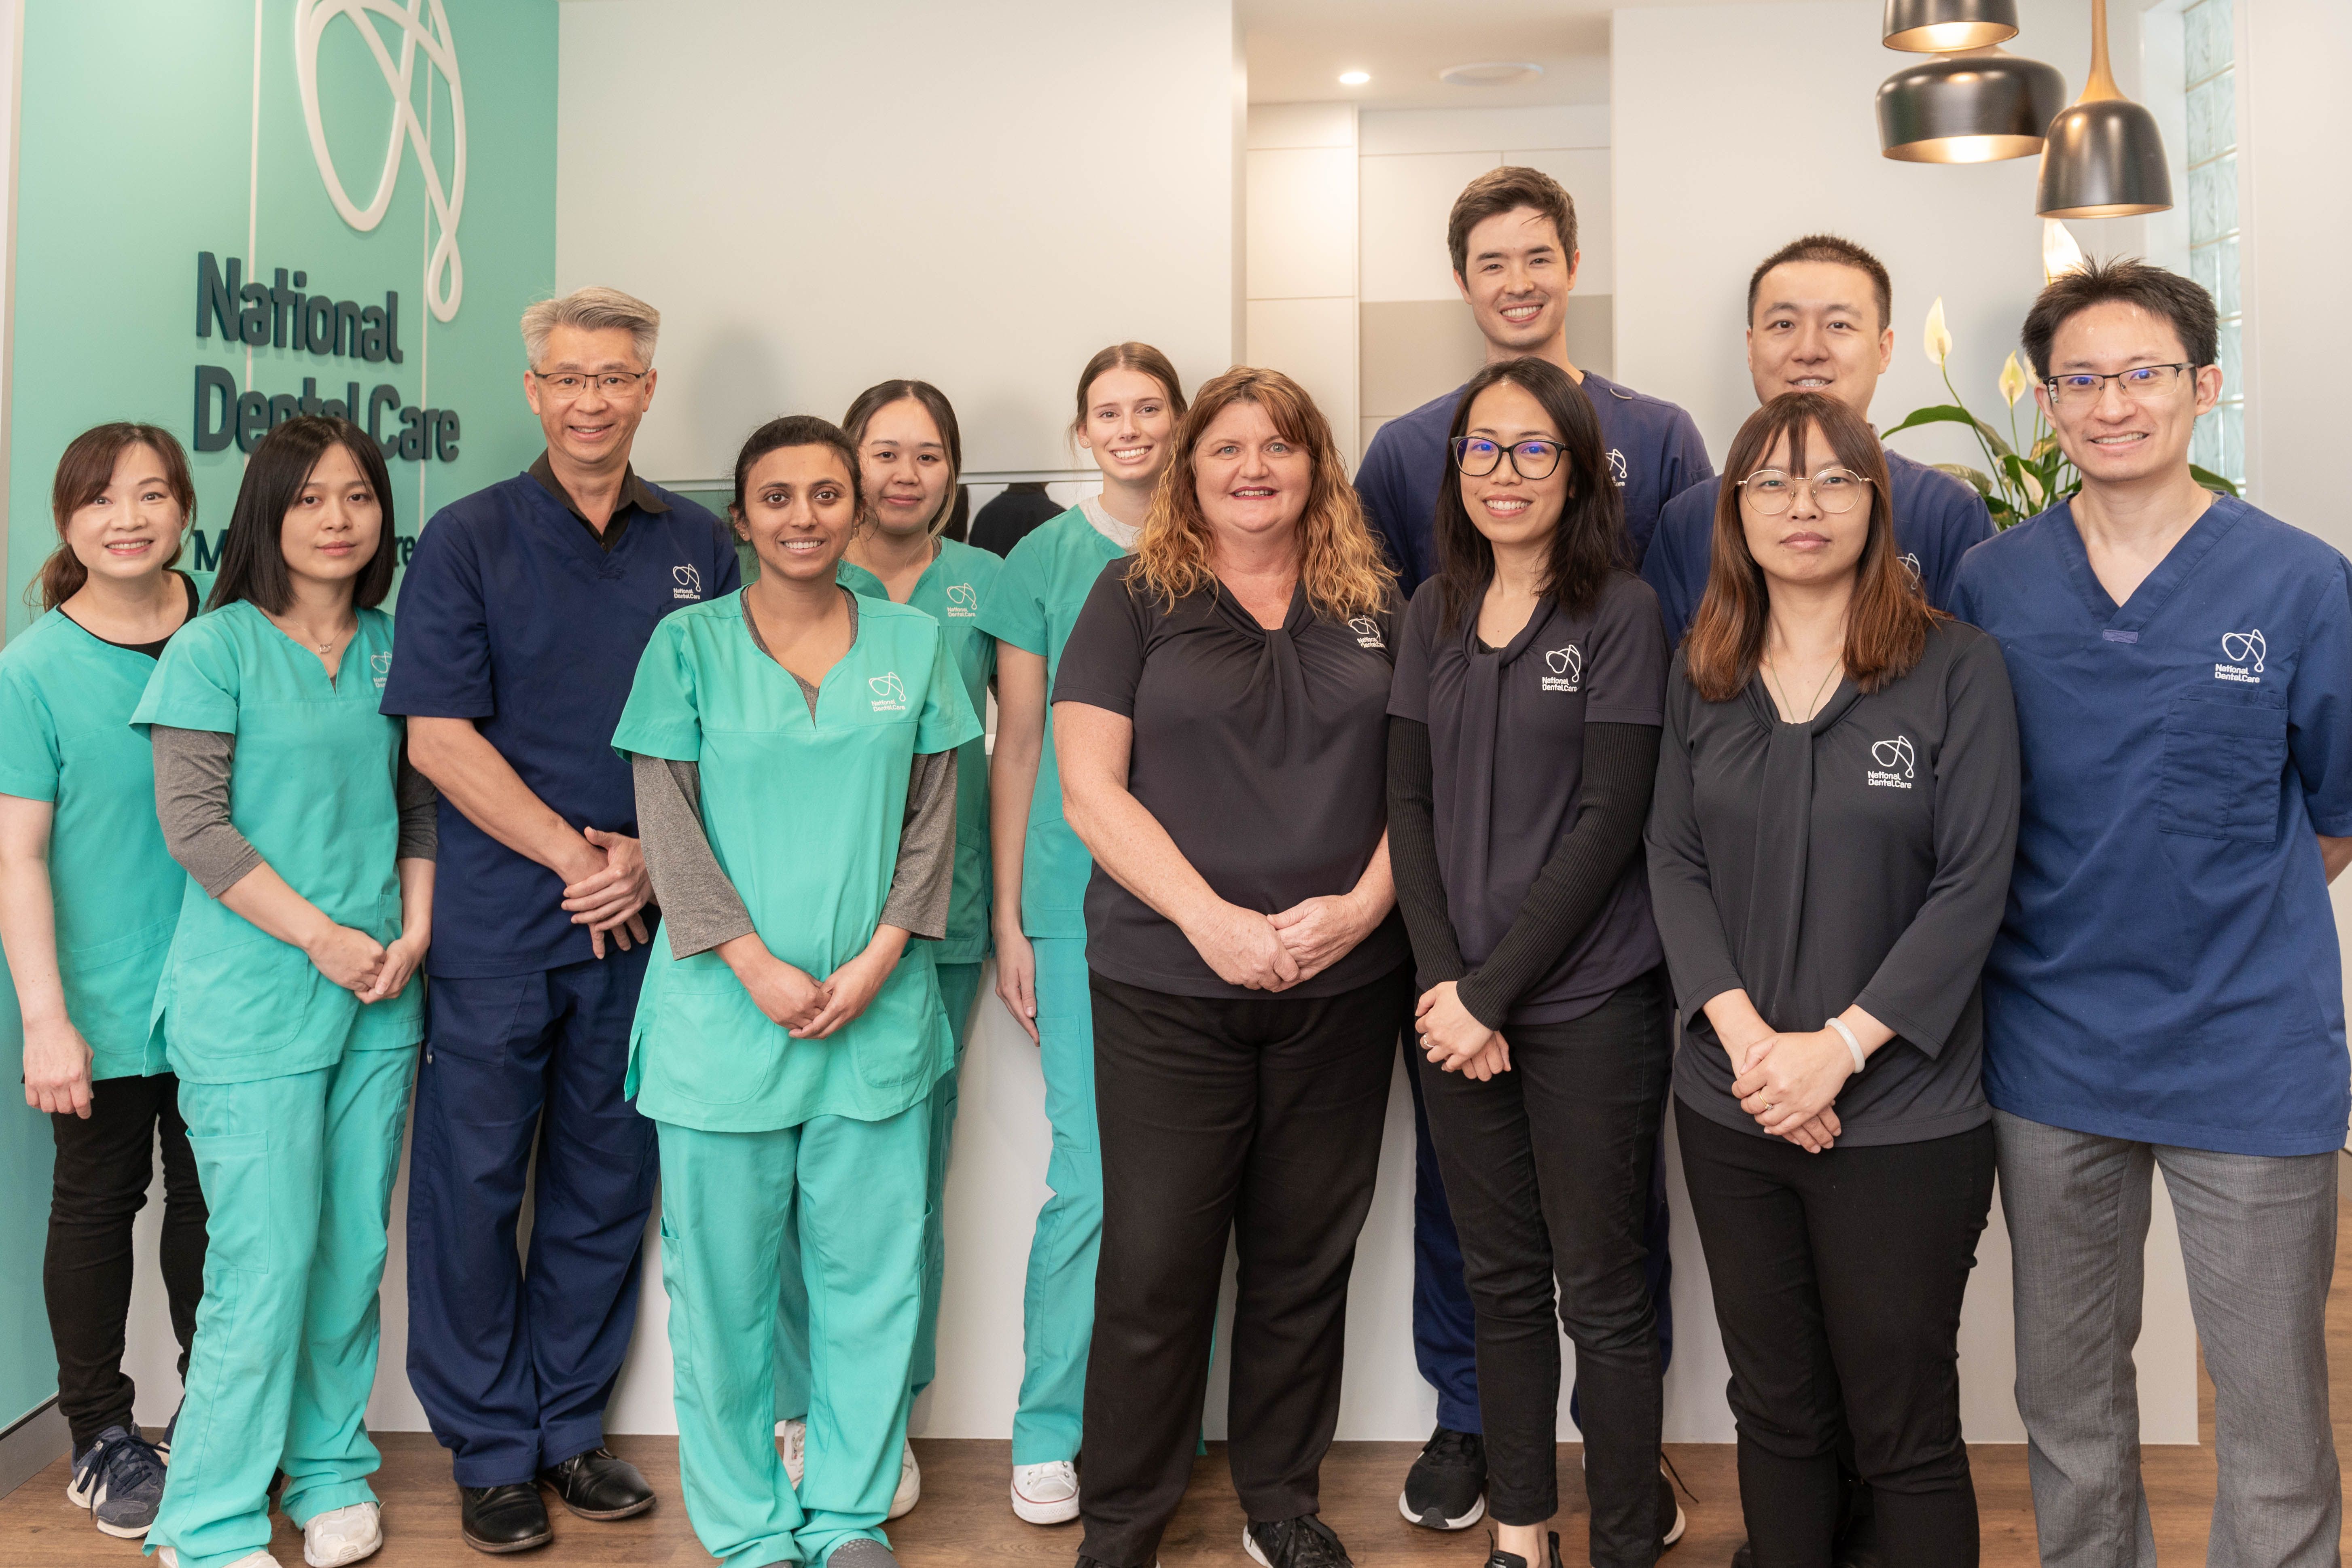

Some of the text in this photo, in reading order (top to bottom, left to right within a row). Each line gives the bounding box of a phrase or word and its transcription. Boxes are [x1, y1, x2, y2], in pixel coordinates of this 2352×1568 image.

[196, 251, 403, 364] National
[367, 384, 460, 462] Care
[2215, 663, 2249, 674] National
[1542, 676, 1569, 685] National
[1867, 771, 1901, 780] National
